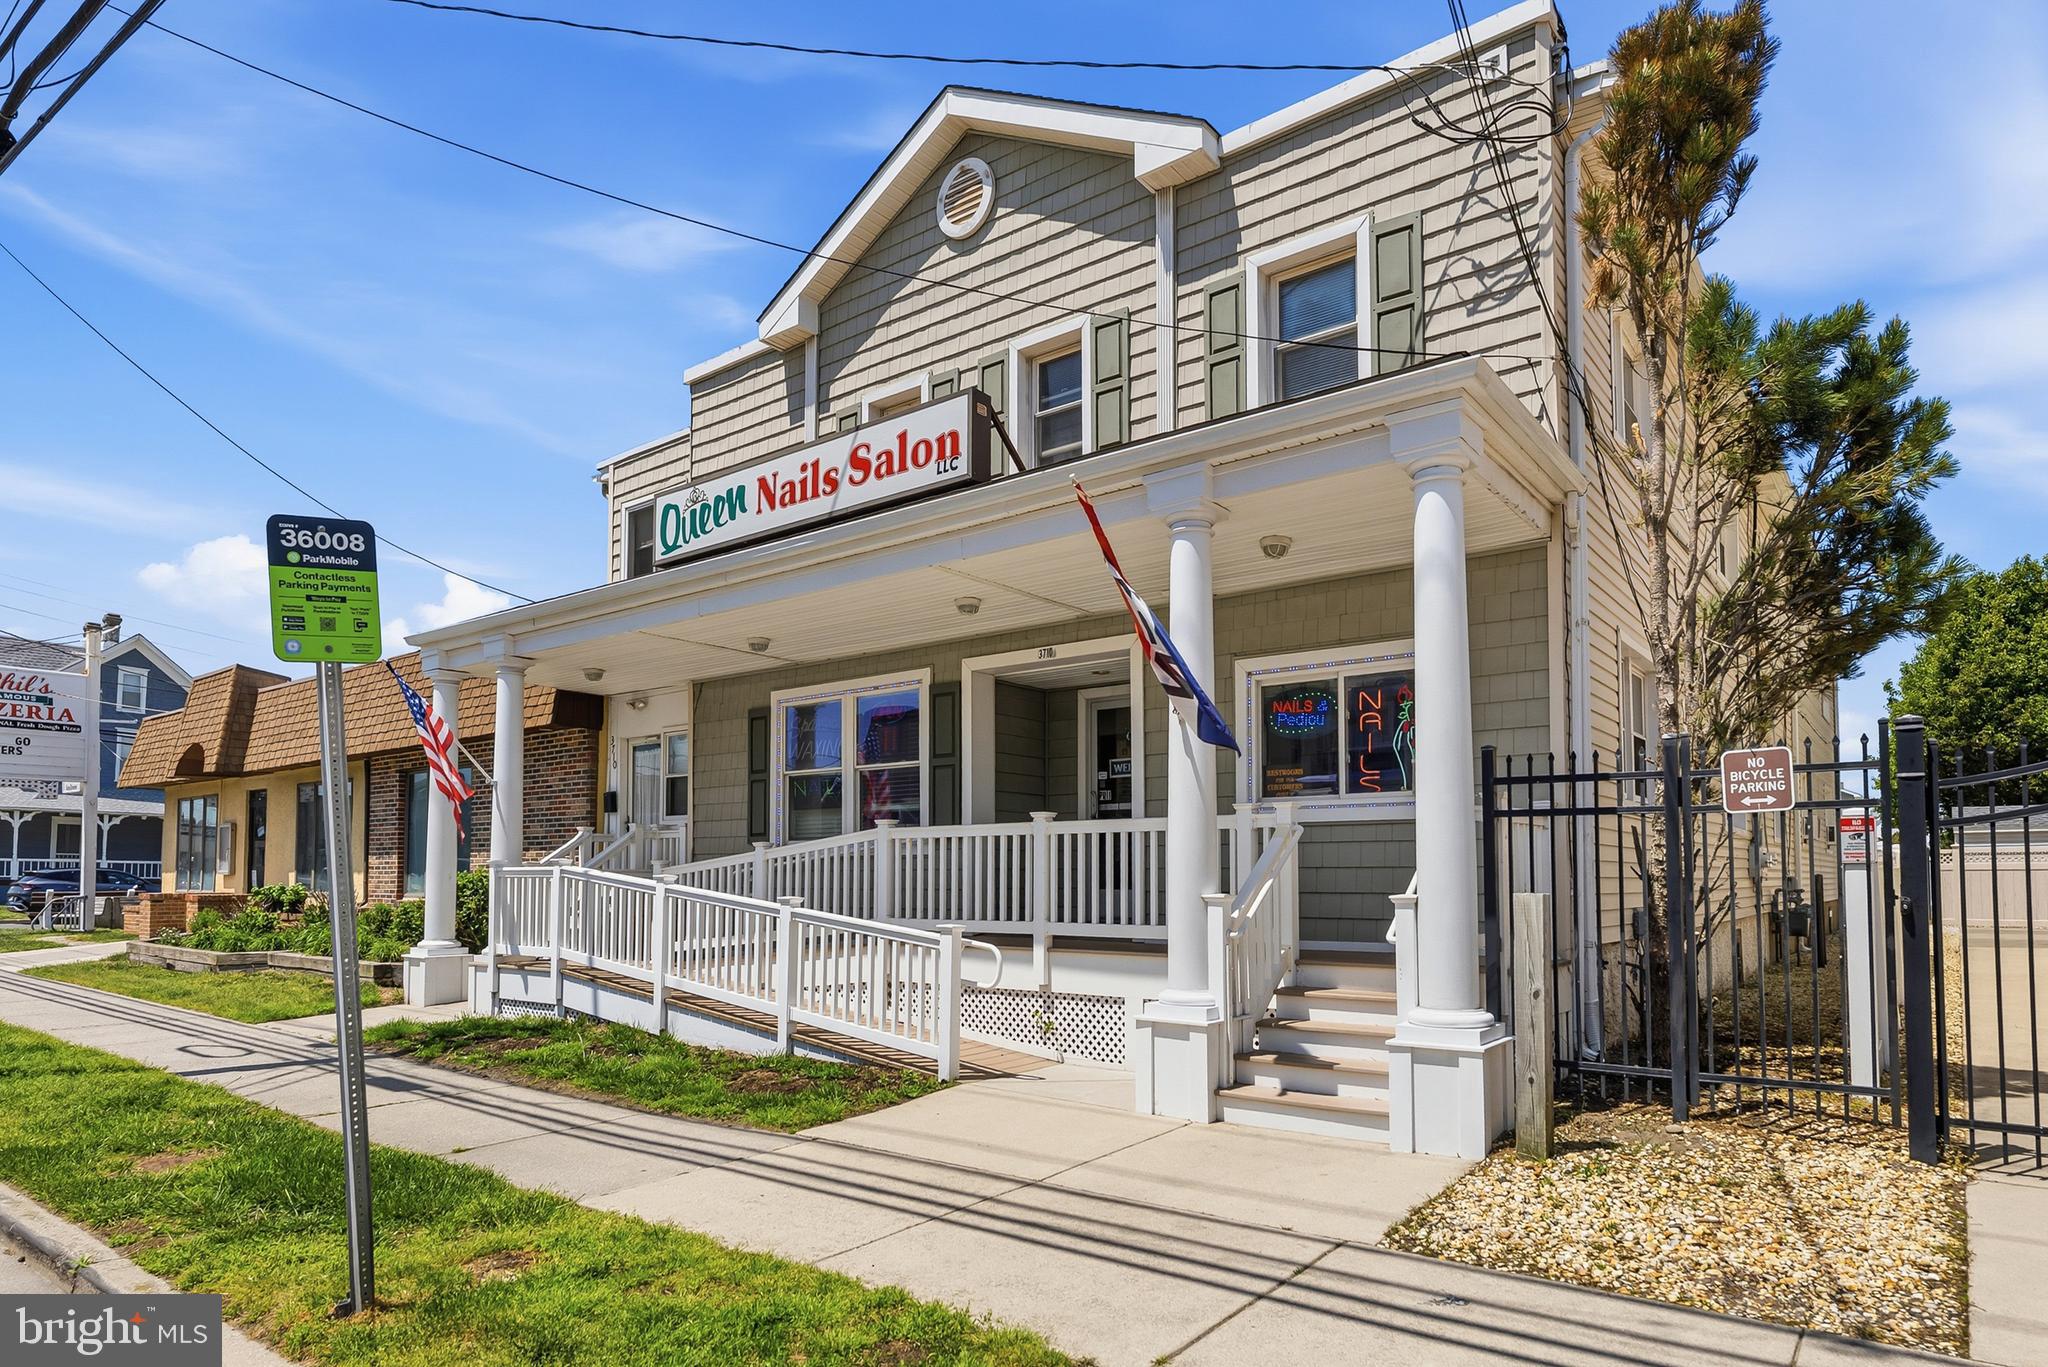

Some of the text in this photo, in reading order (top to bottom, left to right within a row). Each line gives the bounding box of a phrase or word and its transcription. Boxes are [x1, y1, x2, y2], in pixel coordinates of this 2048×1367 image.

[936, 455, 959, 475] LLC
[660, 428, 961, 556] Queen Nails Salon
[280, 529, 365, 552] 36008
[303, 554, 359, 566] ParkMobile
[294, 571, 356, 583] Contactless
[278, 579, 372, 593] Parking Payments
[0, 672, 52, 694] hil's
[1272, 699, 1313, 713] NAILS
[1277, 712, 1325, 727] Pedicu
[38, 723, 60, 731] Dough
[15, 737, 31, 746] GO
[1359, 688, 1382, 792] NAILS
[1747, 757, 1765, 769] NO
[1730, 768, 1785, 782] BICYCLE
[1730, 781, 1786, 794] PARKING
